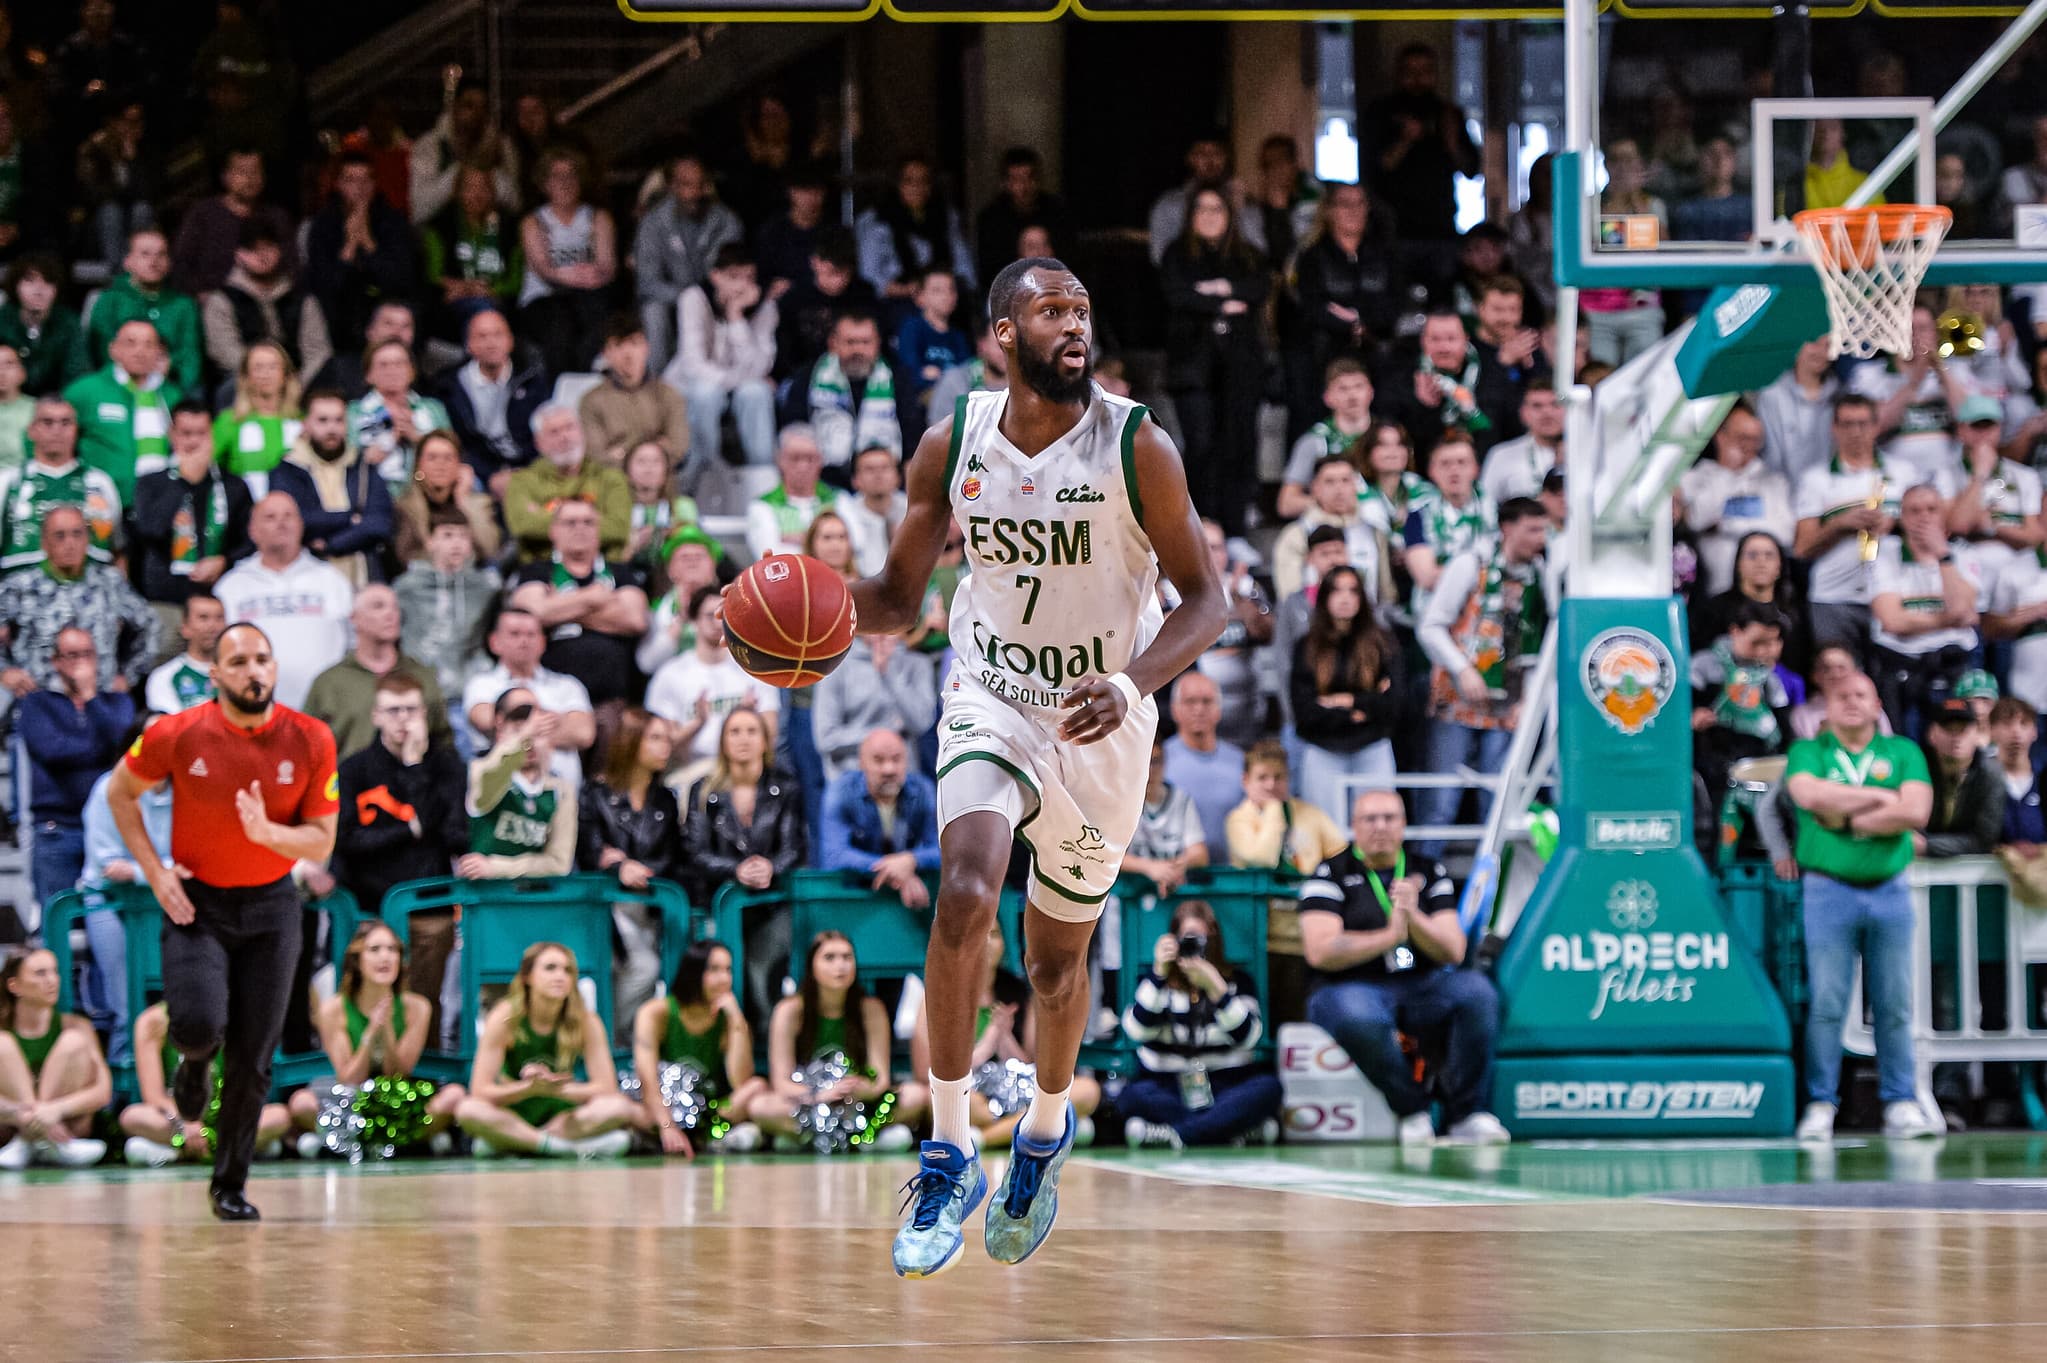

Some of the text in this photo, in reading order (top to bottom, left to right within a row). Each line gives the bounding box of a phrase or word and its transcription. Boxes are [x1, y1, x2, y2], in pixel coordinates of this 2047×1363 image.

[969, 516, 1092, 566] ESSM
[1016, 574, 1041, 625] 7
[979, 669, 1007, 697] SEA
[1589, 963, 1696, 1021] filets
